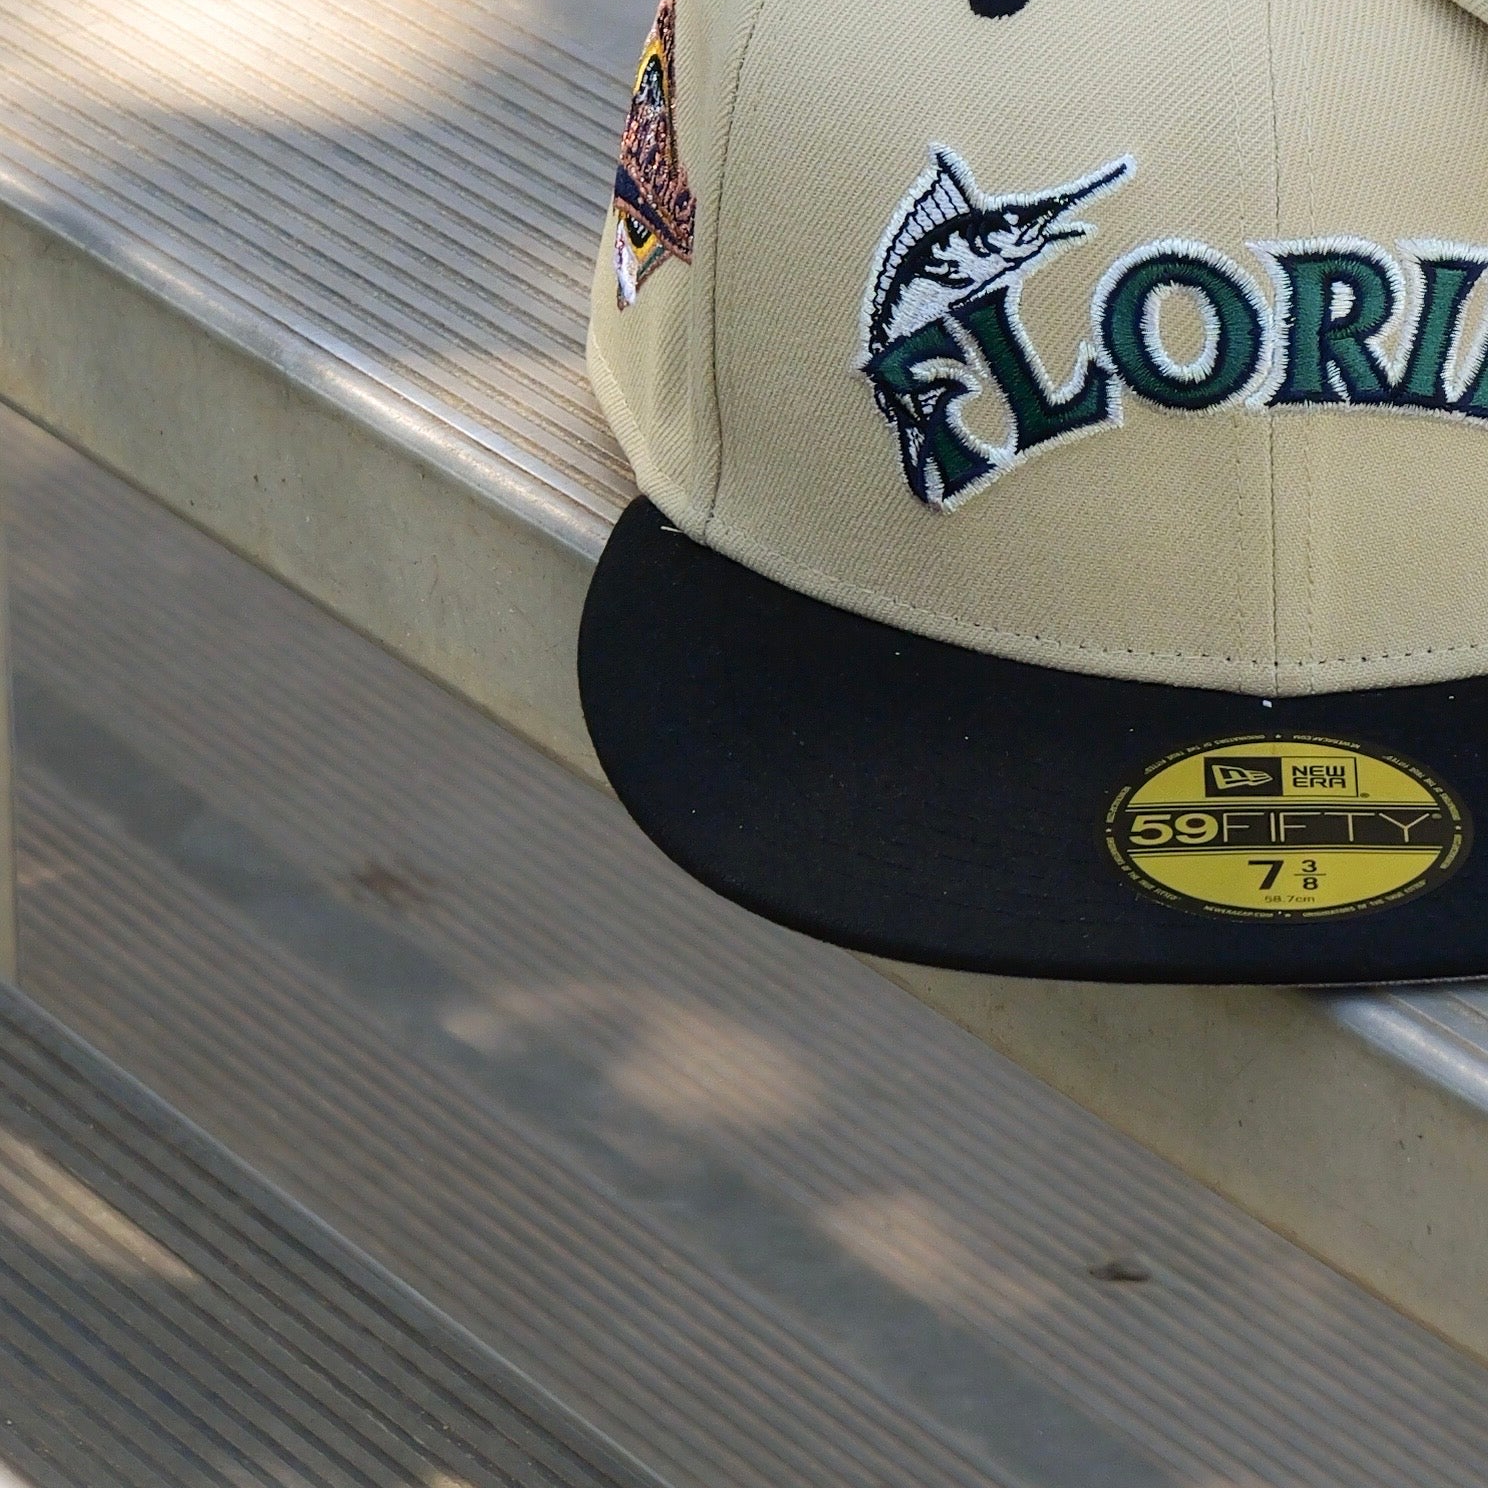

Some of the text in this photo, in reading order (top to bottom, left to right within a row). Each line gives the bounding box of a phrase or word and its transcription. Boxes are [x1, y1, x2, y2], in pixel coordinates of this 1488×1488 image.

[1292, 765, 1346, 777] NEW
[1292, 777, 1347, 789] ERA
[1128, 812, 1430, 847] 59FIFTY
[1247, 859, 1285, 891] 7
[1263, 895, 1316, 904] 58.7cm
